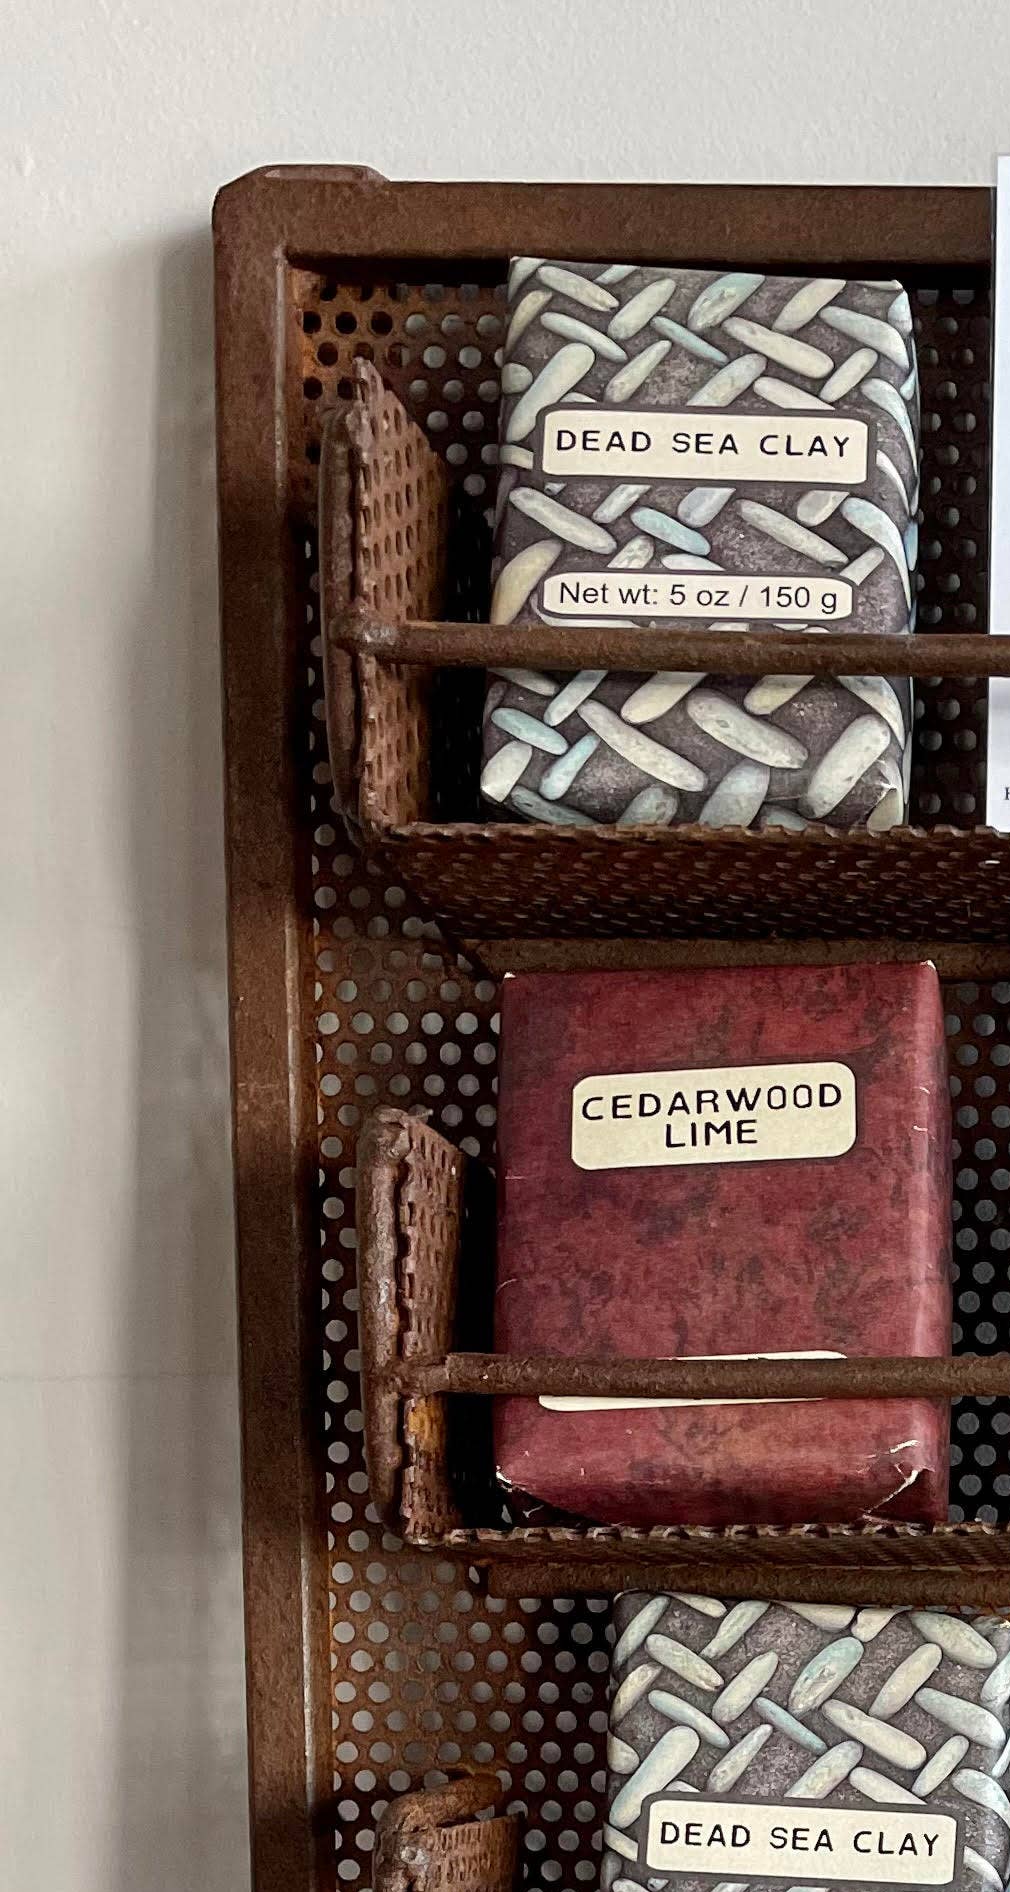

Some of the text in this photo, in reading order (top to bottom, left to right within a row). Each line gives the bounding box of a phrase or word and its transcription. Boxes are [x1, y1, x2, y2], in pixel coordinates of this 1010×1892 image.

[556, 429, 851, 458] DEAD SEA CLAY
[559, 582, 838, 615] Net wt: 5 oz / 150 g
[581, 1082, 842, 1121] CEDARWOOD
[665, 1118, 758, 1149] LIME
[659, 1821, 939, 1857] DEAD SEA CLAY
